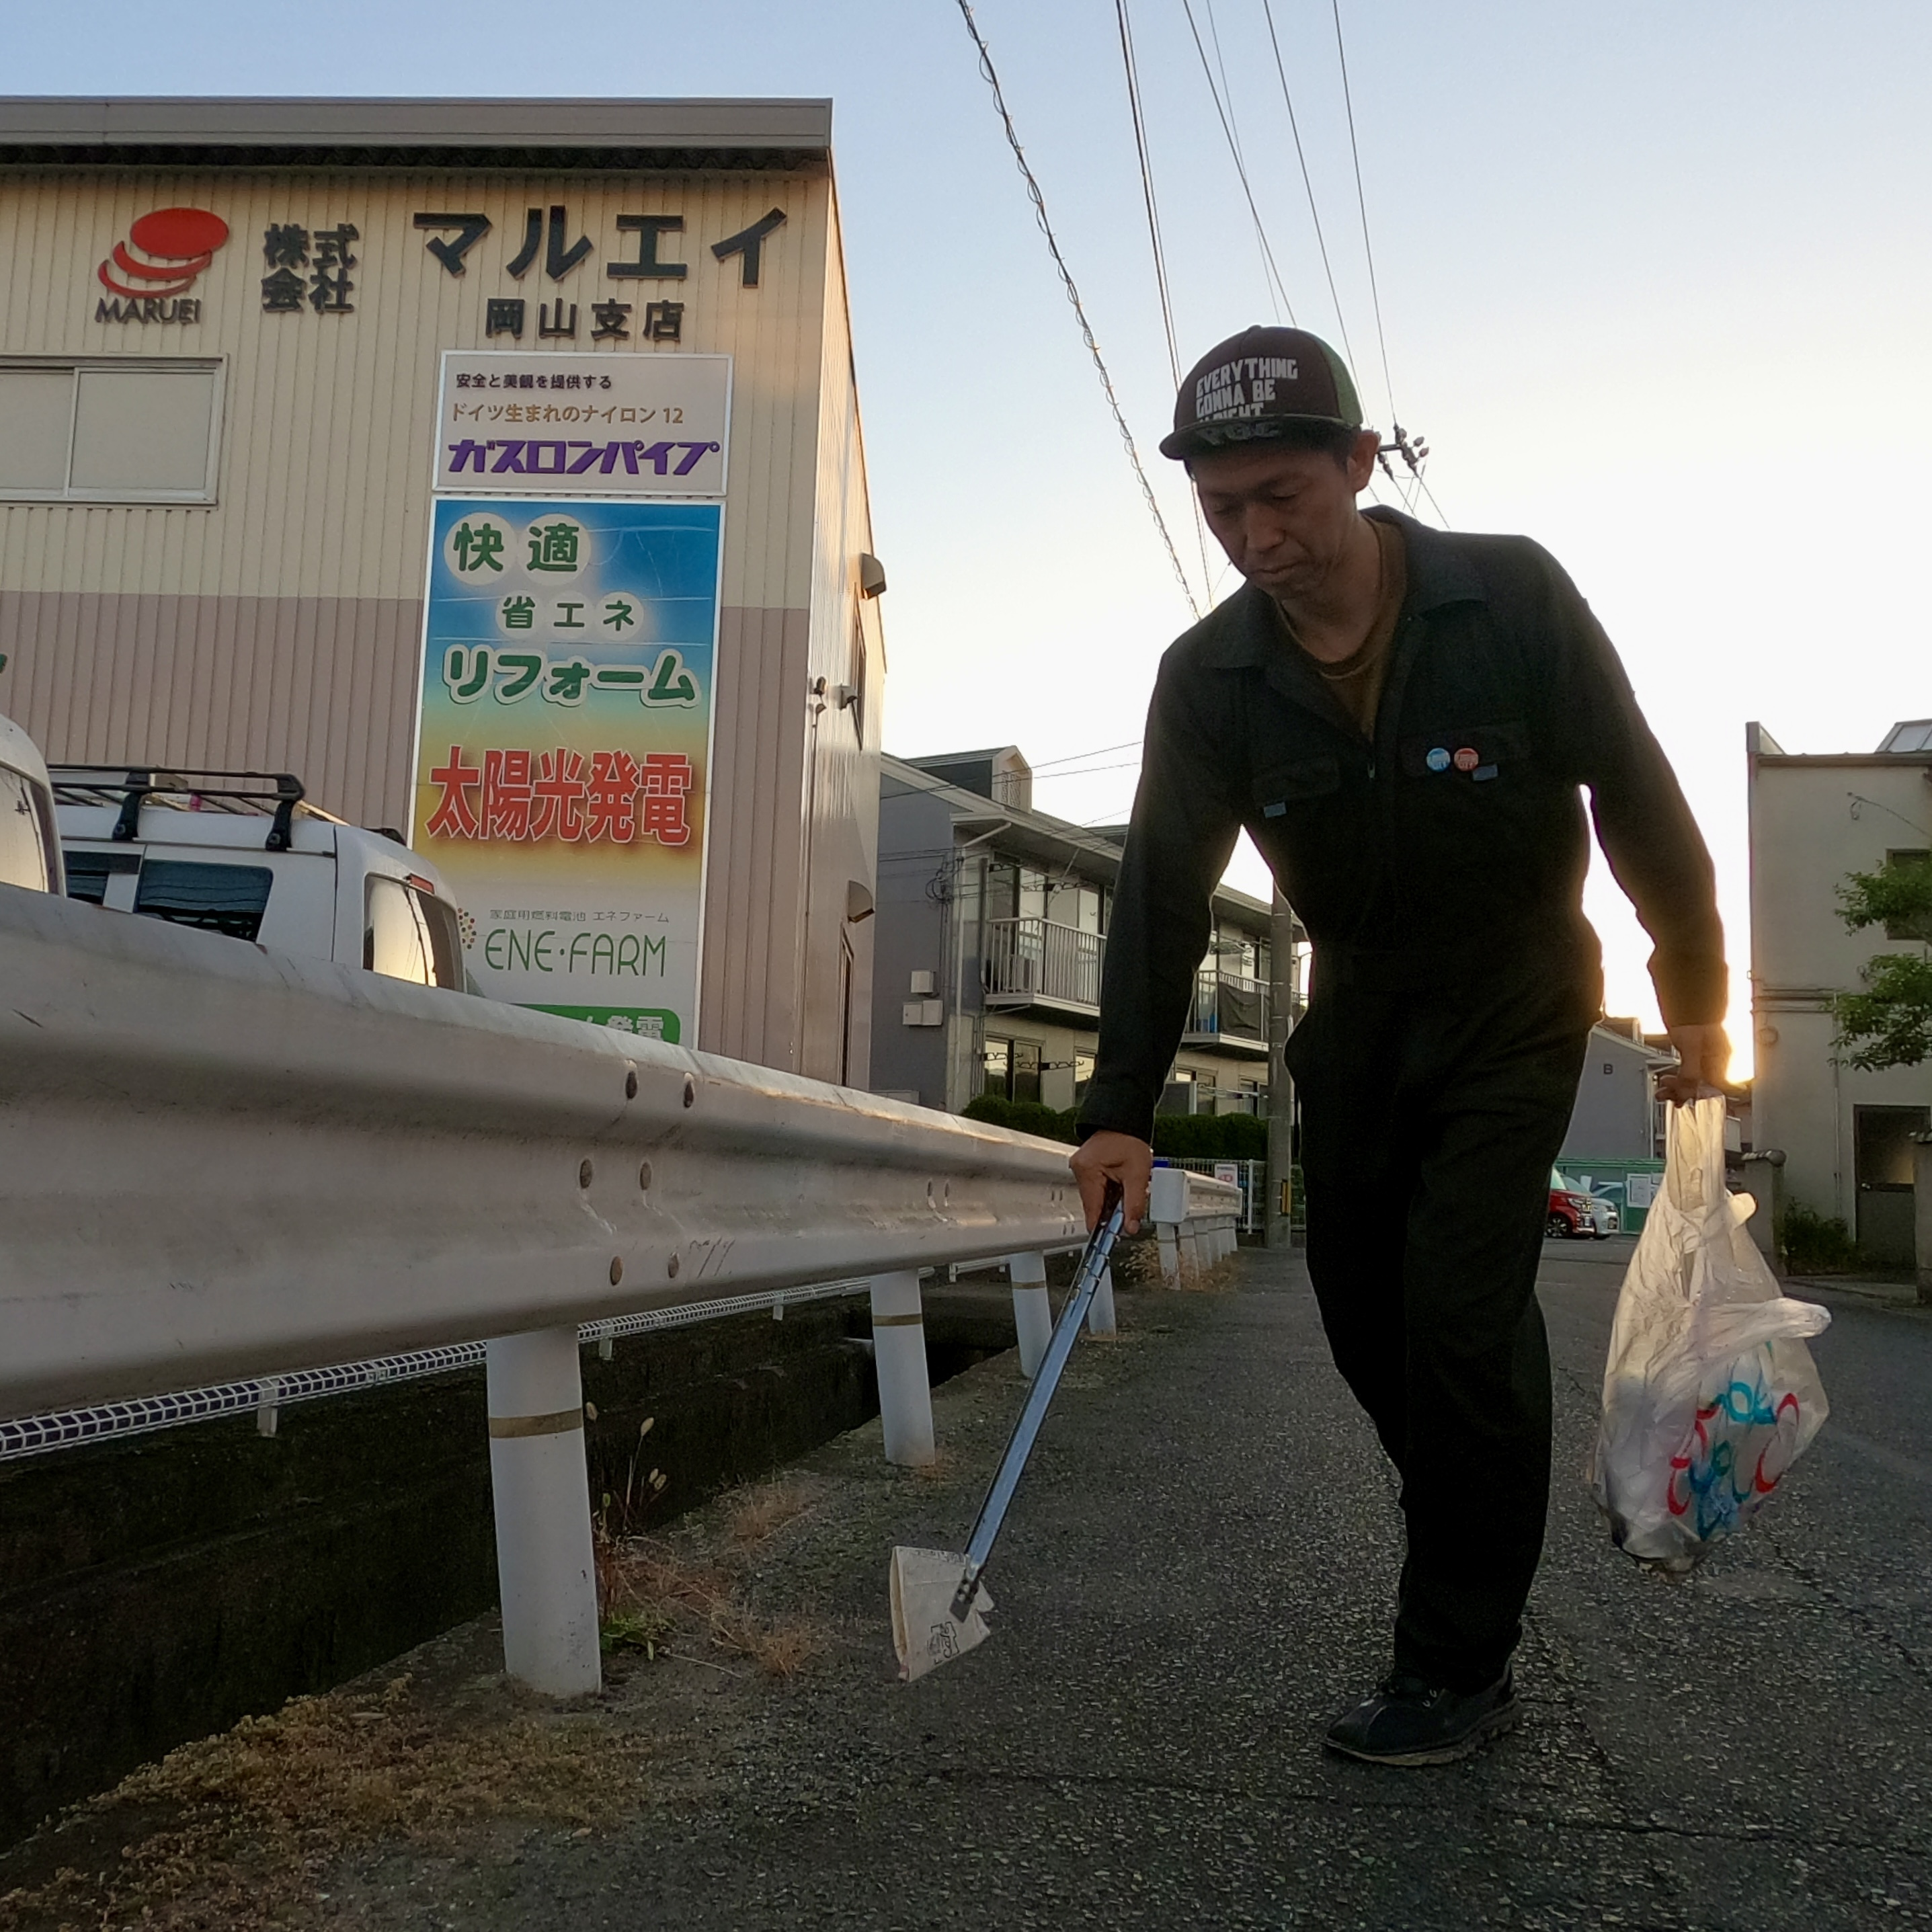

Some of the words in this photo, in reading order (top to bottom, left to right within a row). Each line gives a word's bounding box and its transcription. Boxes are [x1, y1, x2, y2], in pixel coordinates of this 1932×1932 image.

[413, 204, 787, 288] マルエイ
[95, 298, 201, 324] MARUEI
[485, 298, 684, 341] 岡山支店
[455, 372, 612, 390] 安全と美観を提供する
[1196, 358, 1299, 399] EVERYTHING
[1196, 383, 1246, 419] GONNA
[1252, 378, 1276, 403] BE
[452, 403, 657, 424] ドイツ生まれのナイロン
[663, 407, 684, 424] 12
[448, 439, 721, 475] ガスロンパイプ
[452, 522, 580, 572] 快適
[501, 596, 635, 631] 省エネ
[446, 647, 699, 706] リフォーム
[425, 745, 692, 846] 太陽光発電
[593, 910, 670, 923] エネファーム
